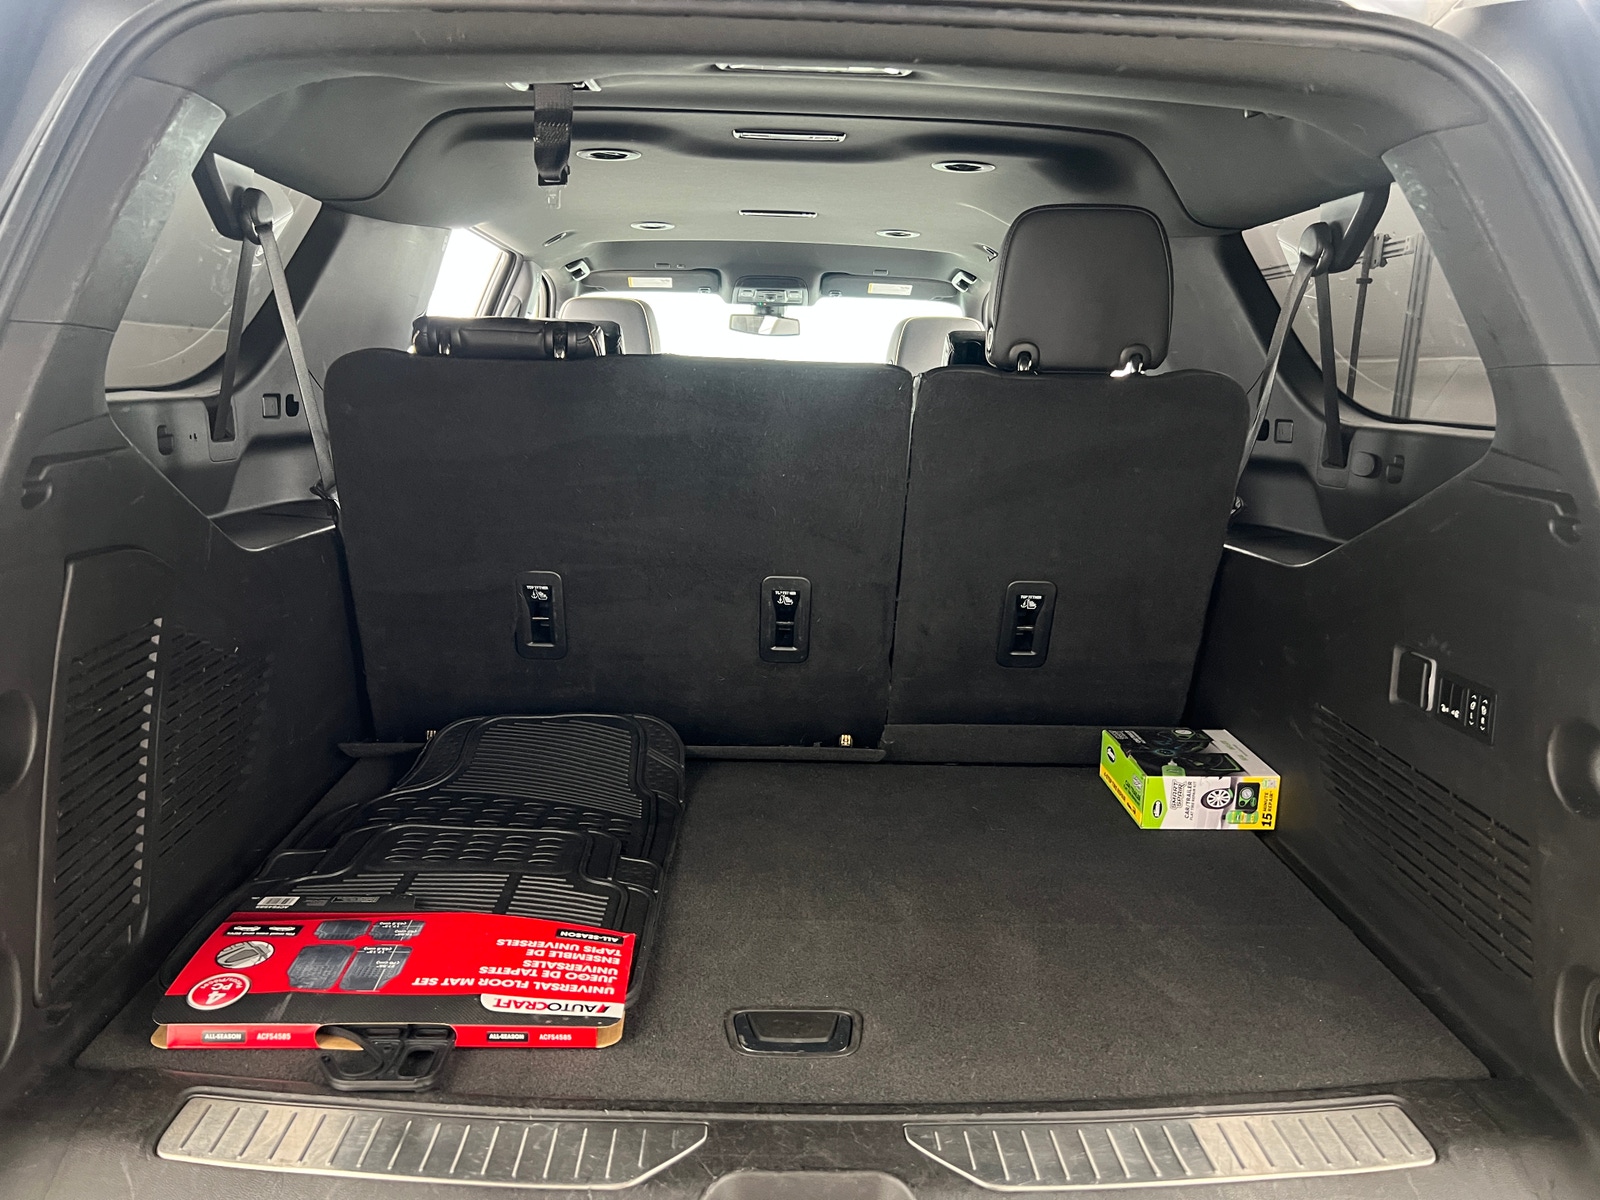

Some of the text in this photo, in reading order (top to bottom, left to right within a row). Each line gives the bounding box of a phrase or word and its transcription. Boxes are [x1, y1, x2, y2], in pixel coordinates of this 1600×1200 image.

[1184, 782, 1192, 818] CAR/TRAILER
[1262, 813, 1273, 827] 15
[559, 930, 619, 944] ALL-SEASON
[496, 938, 622, 956] TAPIS UNIVERSELS
[525, 948, 621, 965] ENSEMBLE DE
[478, 966, 618, 984] JUEGO DE TAPETES
[522, 960, 618, 976] UNIVERSALES
[210, 982, 234, 991] PC
[411, 977, 616, 996] UNIVERSAL FLOOR MAT SET
[206, 990, 227, 1005] 4
[492, 998, 597, 1014] AUTOCRAFT
